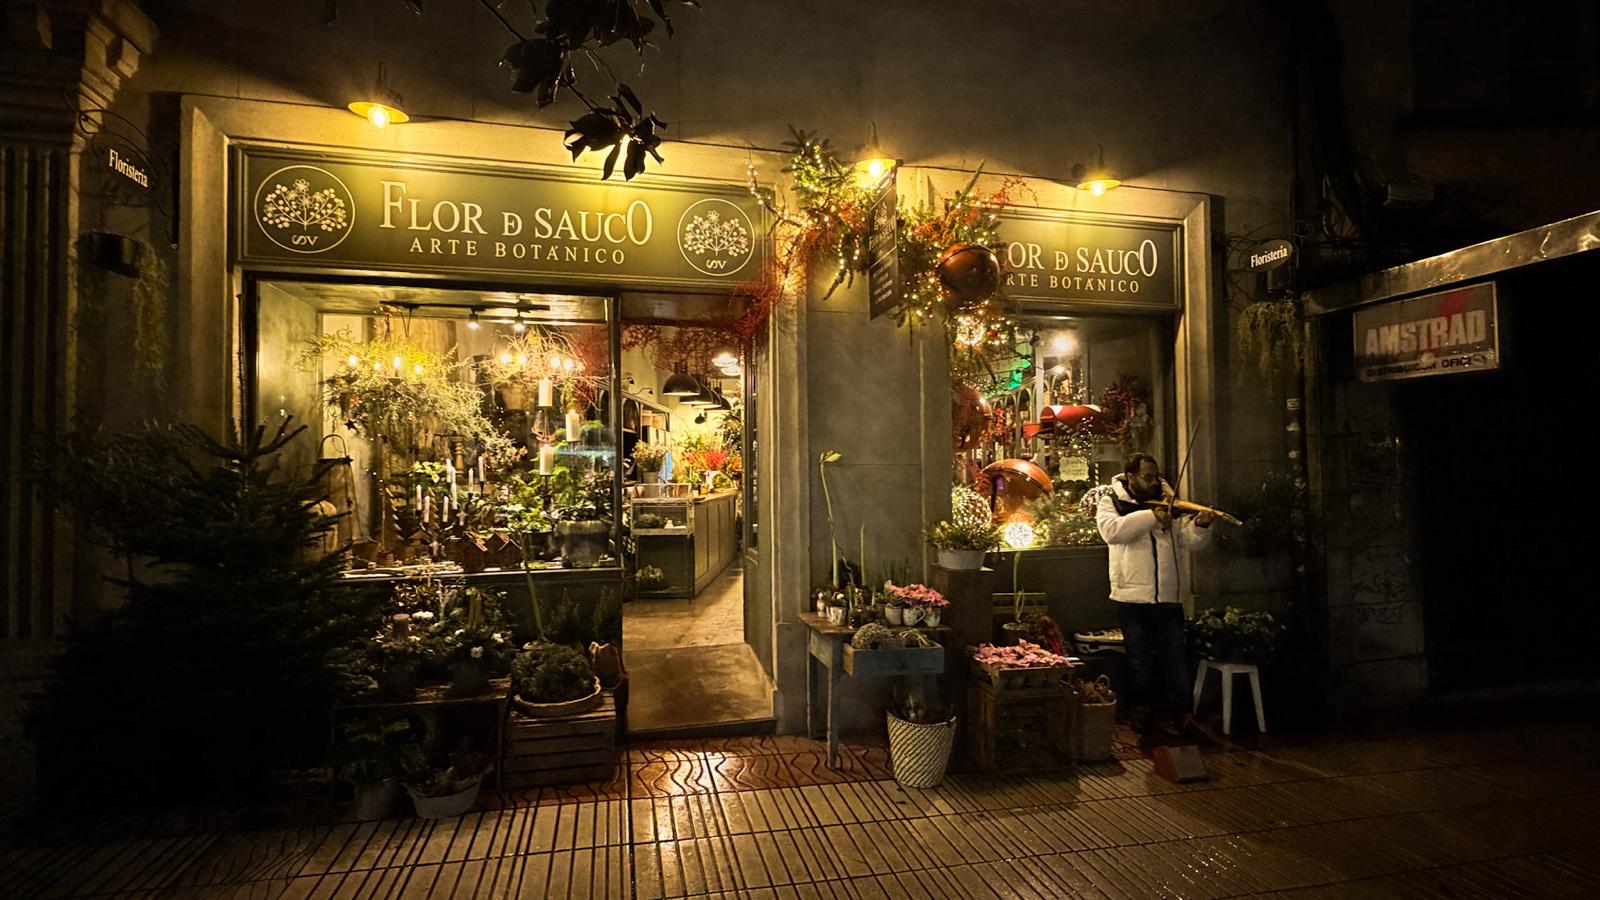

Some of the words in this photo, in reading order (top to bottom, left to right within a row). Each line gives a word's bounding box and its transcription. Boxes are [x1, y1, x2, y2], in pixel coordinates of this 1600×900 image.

[379, 180, 489, 235] FLOR
[534, 200, 653, 245] SAUCO
[409, 237, 478, 256] ARTE
[495, 242, 625, 264] BOTÁNICO
[1007, 241, 1045, 270] OR
[1076, 239, 1158, 277] SAUCO
[1006, 273, 1038, 288] RTE
[1050, 275, 1140, 294] BOTÁNICO
[1365, 310, 1486, 355] AMSTRAD
